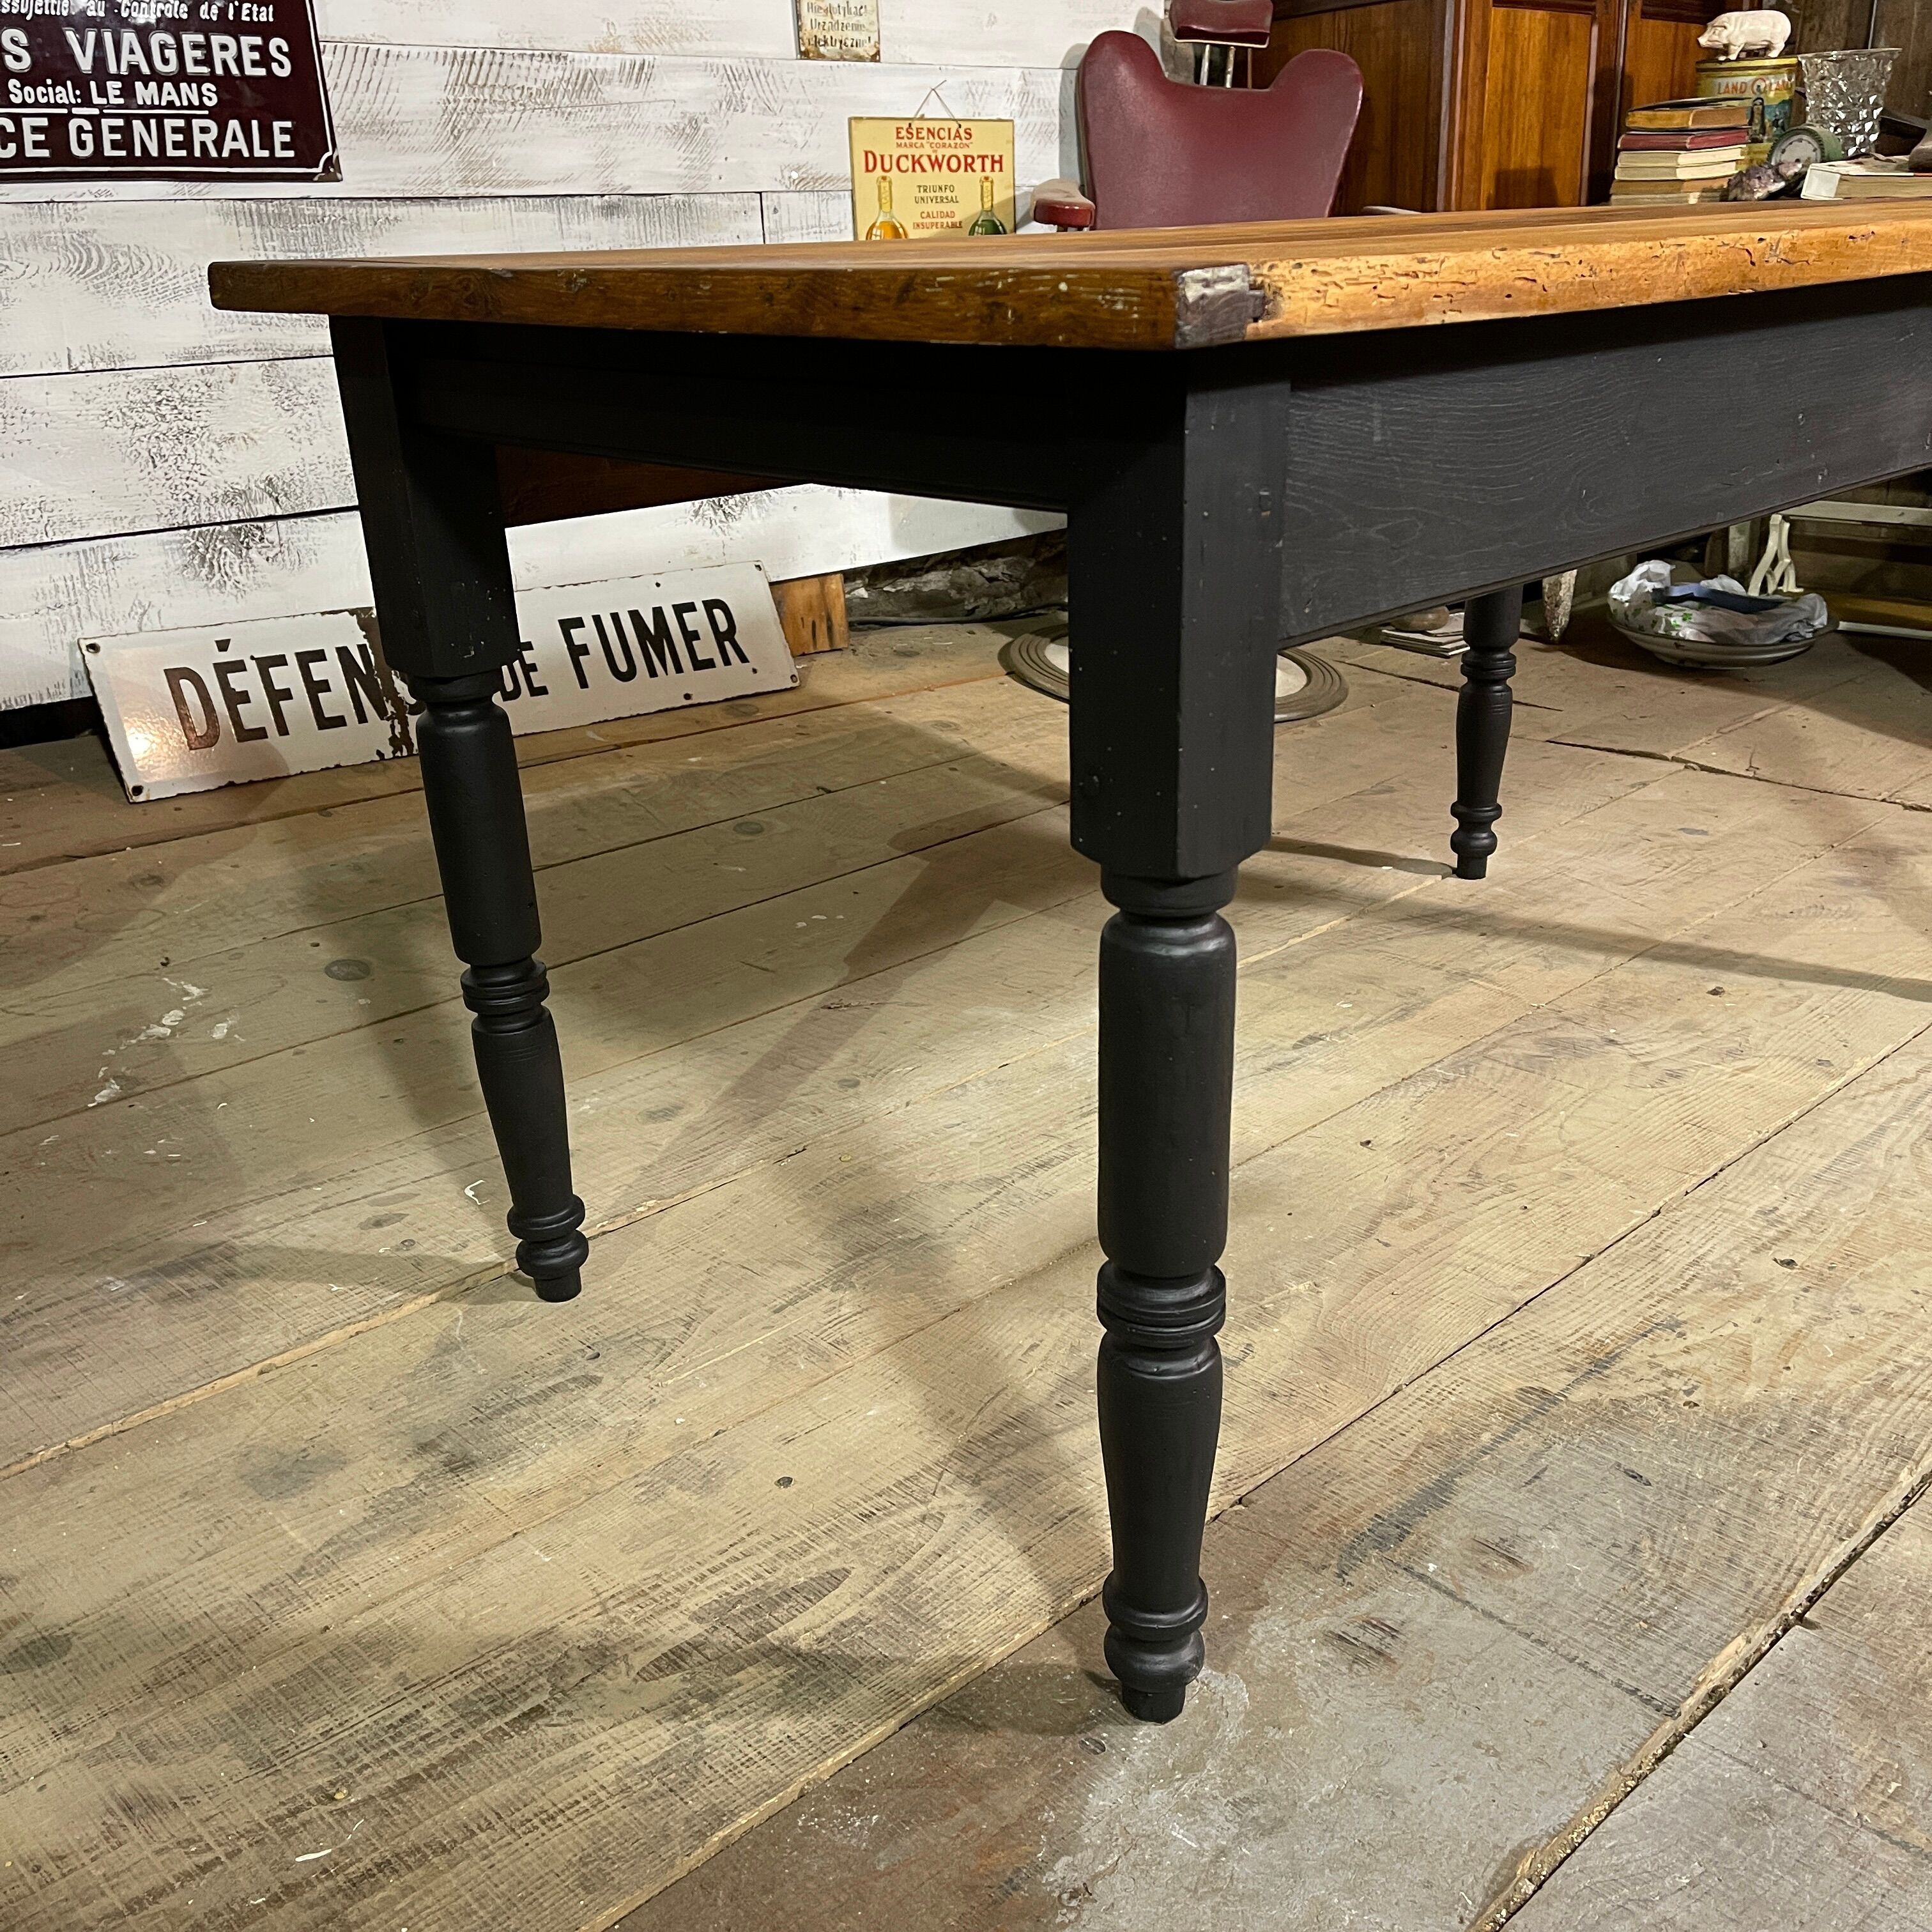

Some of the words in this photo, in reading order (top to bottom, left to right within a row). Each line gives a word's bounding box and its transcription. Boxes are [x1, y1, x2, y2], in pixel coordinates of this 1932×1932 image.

[87, 0, 106, 17] au
[199, 1, 218, 21] de
[64, 28, 293, 77] VIAGERES
[8, 78, 82, 104] Social:
[89, 80, 125, 104] LE
[134, 80, 218, 107] MANS
[1717, 81, 1748, 95] LAND
[68, 118, 296, 158] GENERALE
[895, 126, 973, 141] ESENCIAS
[863, 150, 1004, 173] DUCKWORTH
[916, 184, 955, 194] TRIUNFO
[914, 195, 960, 204] UNIVERSAL
[920, 211, 956, 219] CALIDAD
[912, 221, 963, 229] INSUPERABLE
[558, 598, 750, 689] FUMER
